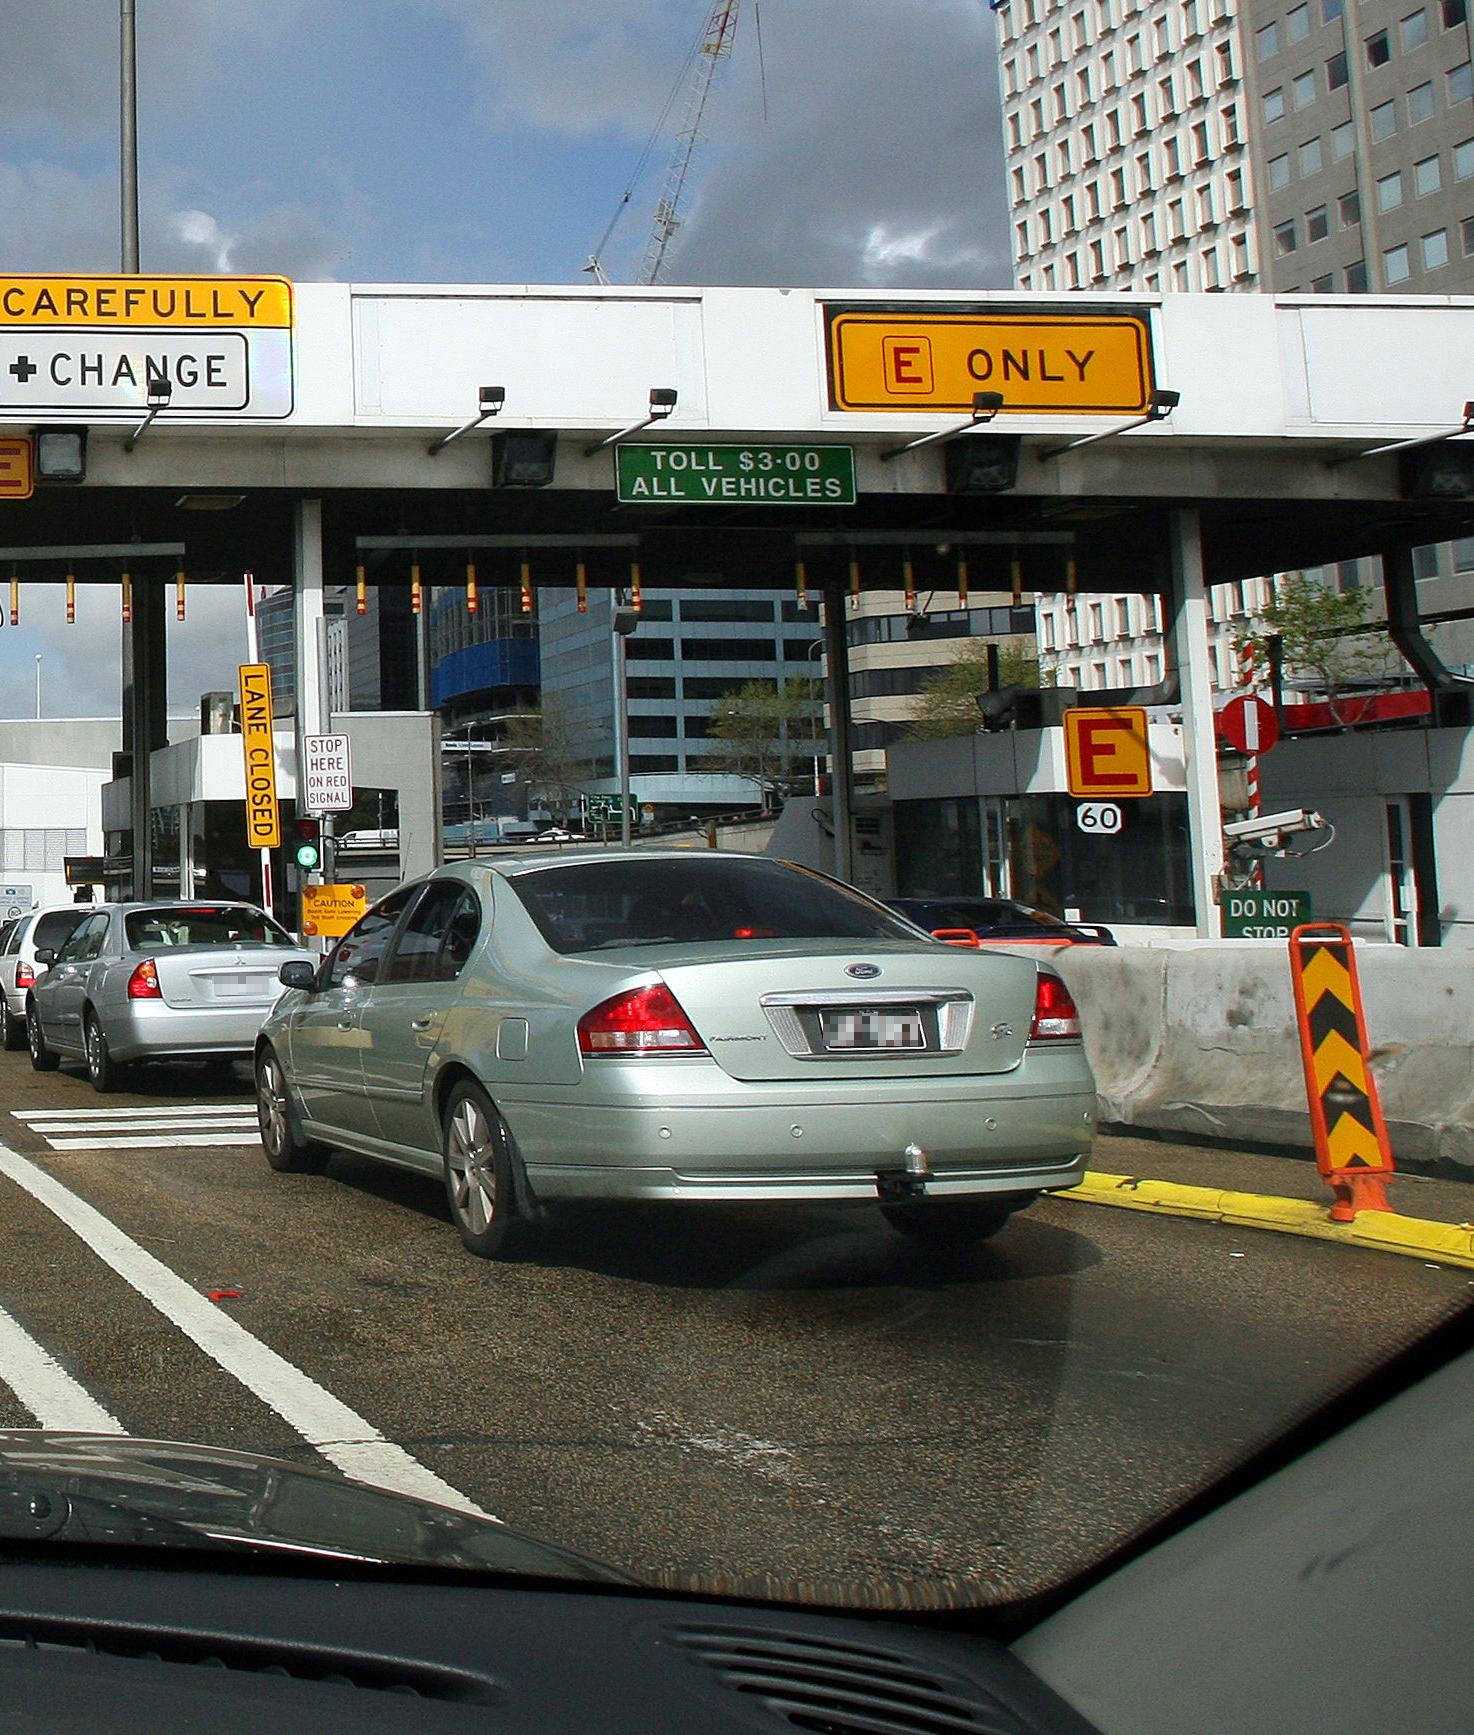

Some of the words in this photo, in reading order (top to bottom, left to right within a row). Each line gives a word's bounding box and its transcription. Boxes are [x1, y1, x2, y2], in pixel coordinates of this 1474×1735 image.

[3, 288, 264, 317] CAREFULLY
[51, 353, 226, 387] CHANGE
[893, 347, 922, 383] E
[968, 349, 1094, 381] ONLY
[651, 452, 723, 470] TOLL
[632, 477, 685, 495] ALL
[701, 477, 842, 497] VEHICLES
[245, 673, 268, 735] LANE
[311, 739, 342, 753] STOP
[1077, 718, 1138, 785] E
[311, 757, 343, 771] HERE
[309, 777, 323, 787] ON
[326, 776, 346, 787] RED
[249, 748, 273, 837] CLOSED
[309, 792, 347, 805] SIGNAL
[1081, 807, 1118, 829] 60
[313, 899, 355, 908] CAUTION
[1231, 900, 1256, 916] DO
[1263, 900, 1298, 917] NOT
[1243, 927, 1289, 938] STOP
